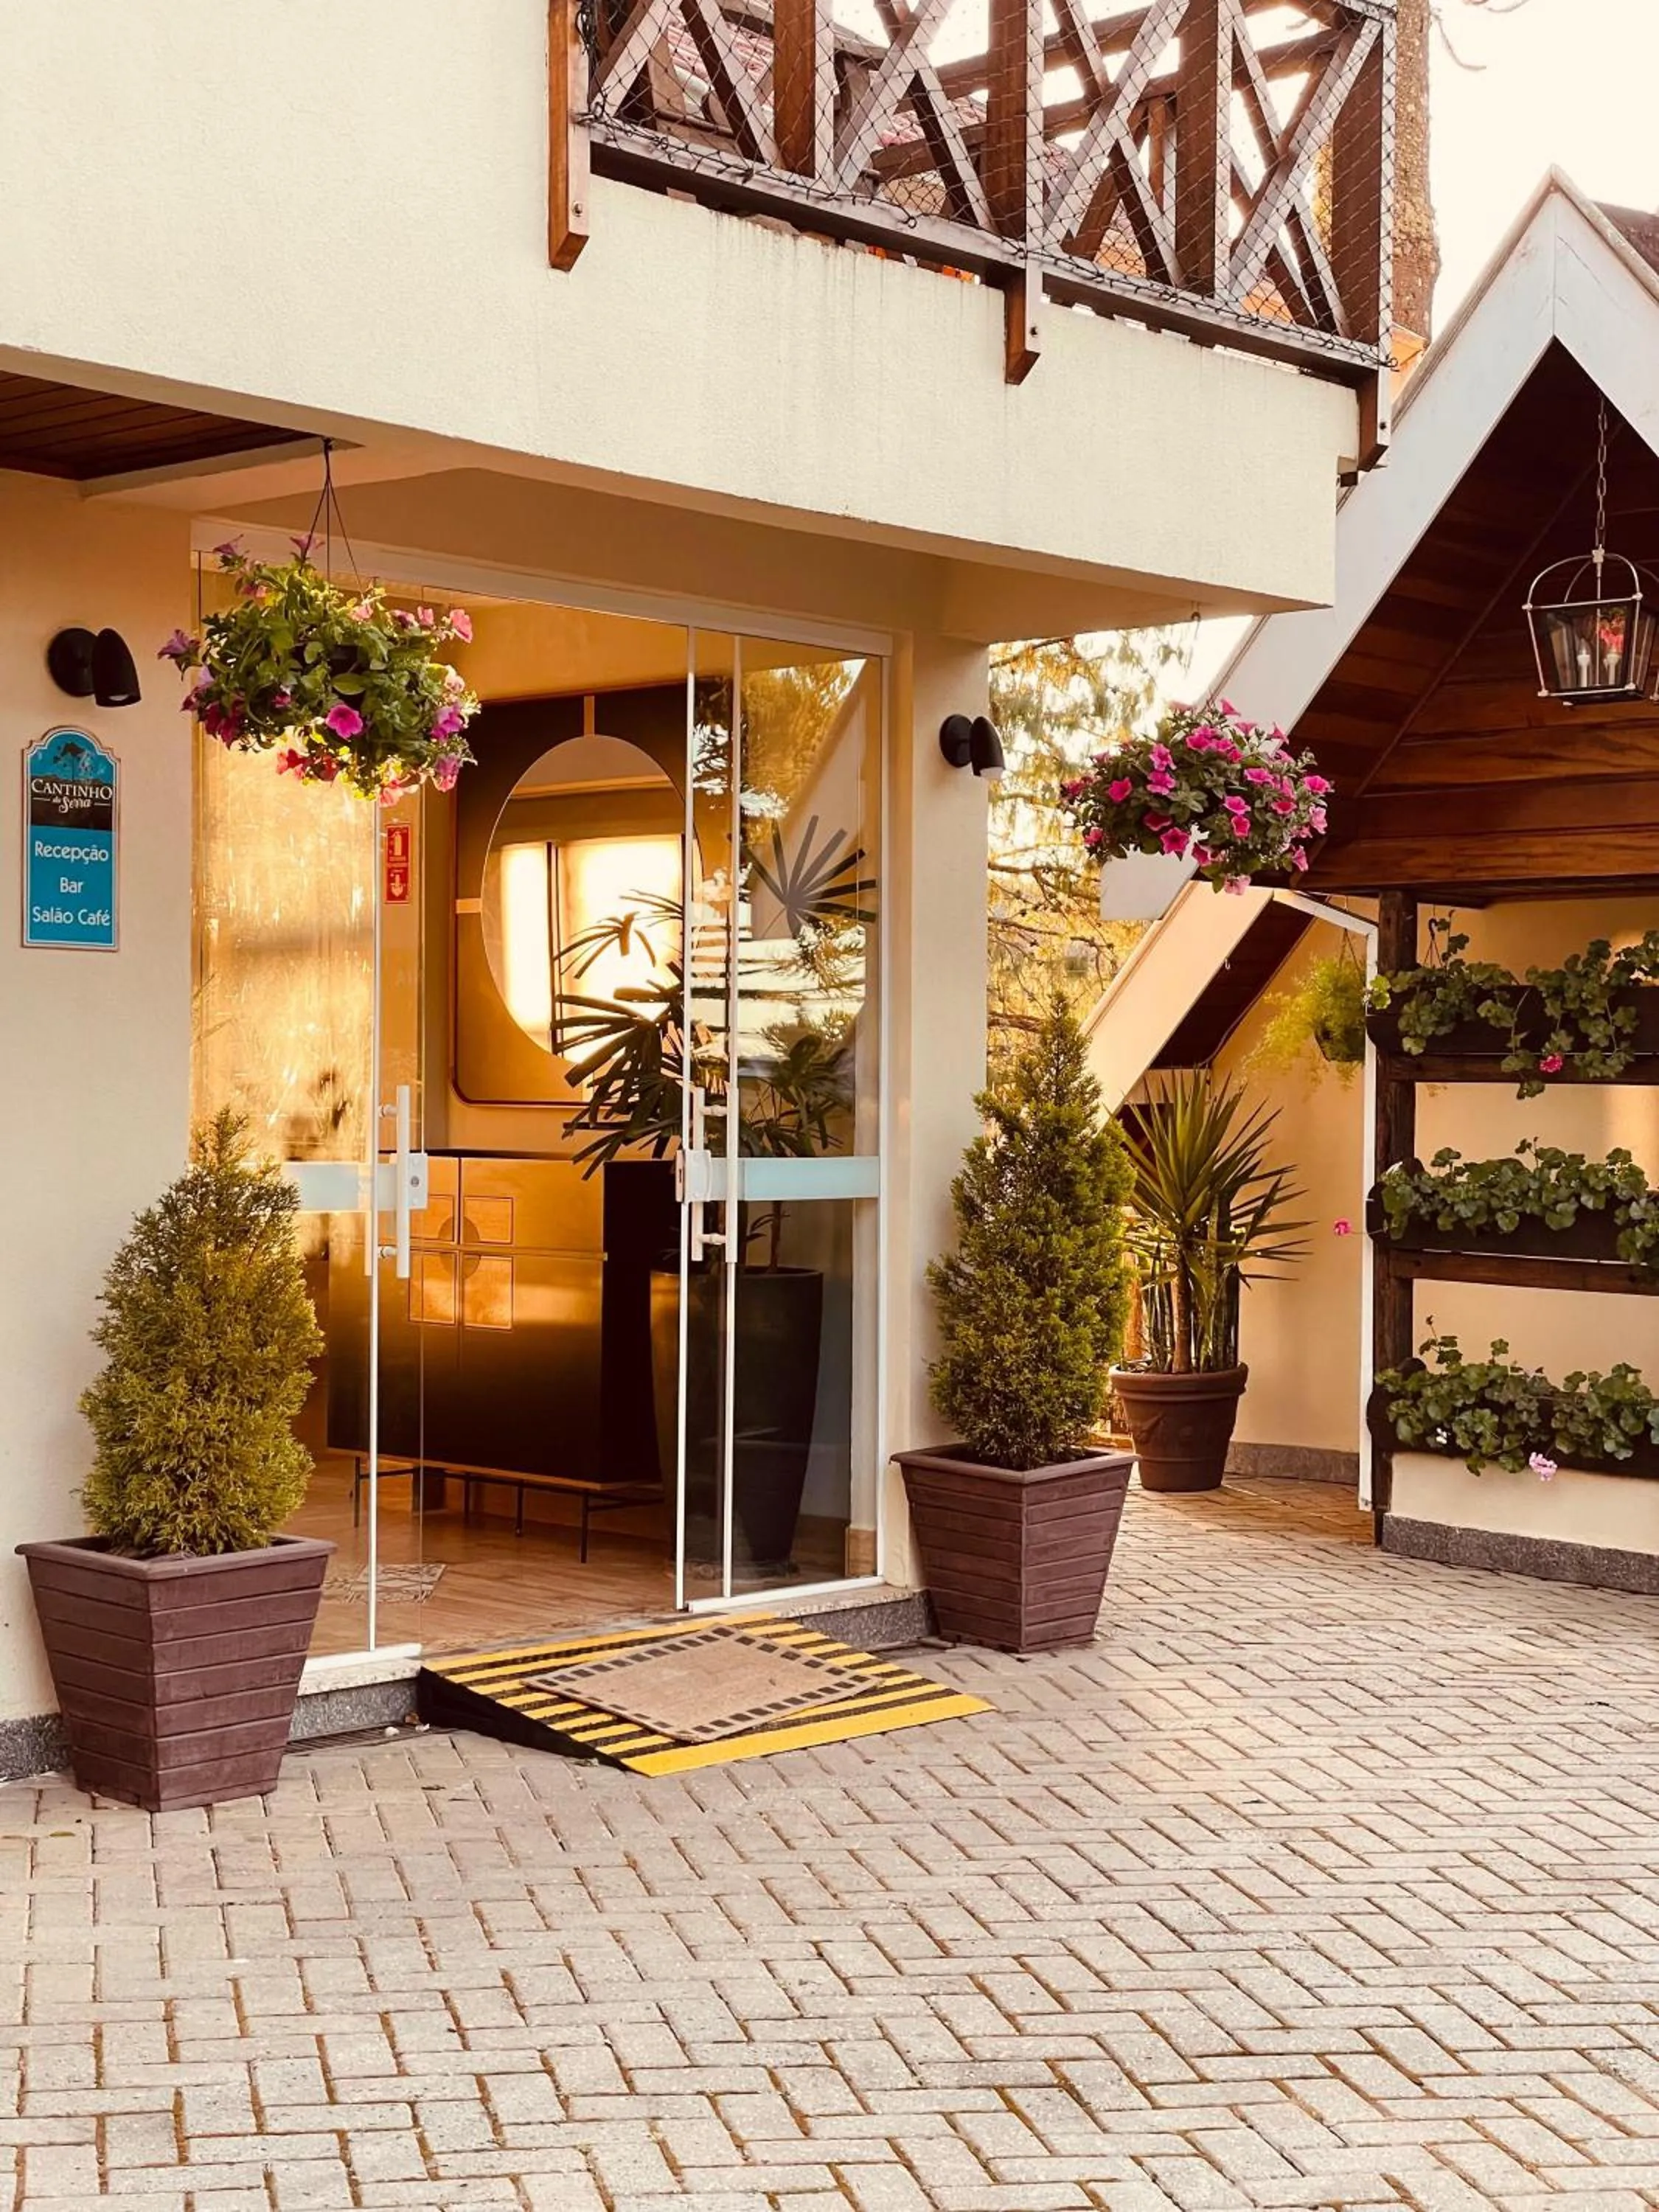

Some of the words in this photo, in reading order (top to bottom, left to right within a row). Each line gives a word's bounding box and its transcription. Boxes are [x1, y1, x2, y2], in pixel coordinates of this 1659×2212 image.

[32, 779, 112, 800] CANTINHO
[35, 841, 109, 864] Recepção
[60, 877, 83, 894] Bar
[32, 907, 73, 925] Salão
[78, 909, 111, 926] Café
